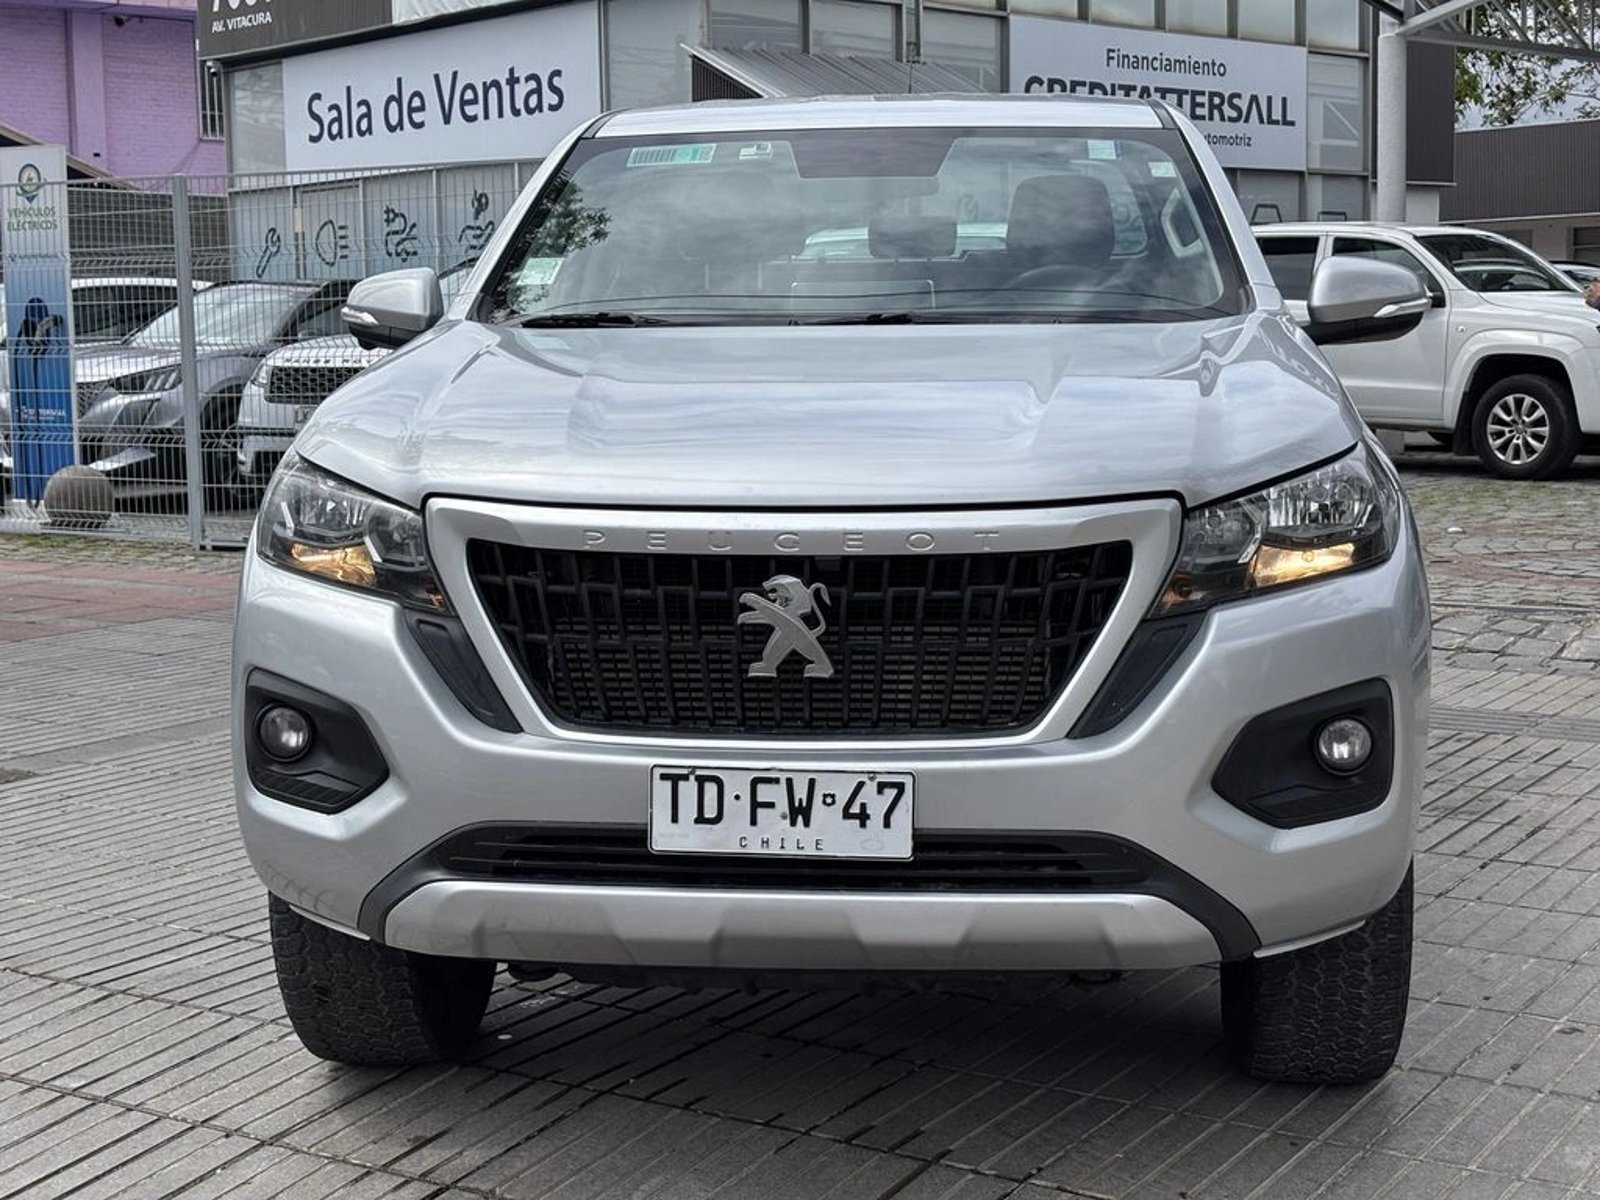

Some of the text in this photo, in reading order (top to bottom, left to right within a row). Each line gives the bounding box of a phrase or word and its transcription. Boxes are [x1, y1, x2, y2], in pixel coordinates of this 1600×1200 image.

[226, 12, 272, 30] VITACURA
[1106, 48, 1227, 78] Financiamiento
[307, 65, 565, 143] Sala de Ventas
[1204, 133, 1252, 147] tomotriz
[583, 529, 999, 551] PEUGEOT
[738, 836, 824, 851] CHILE
